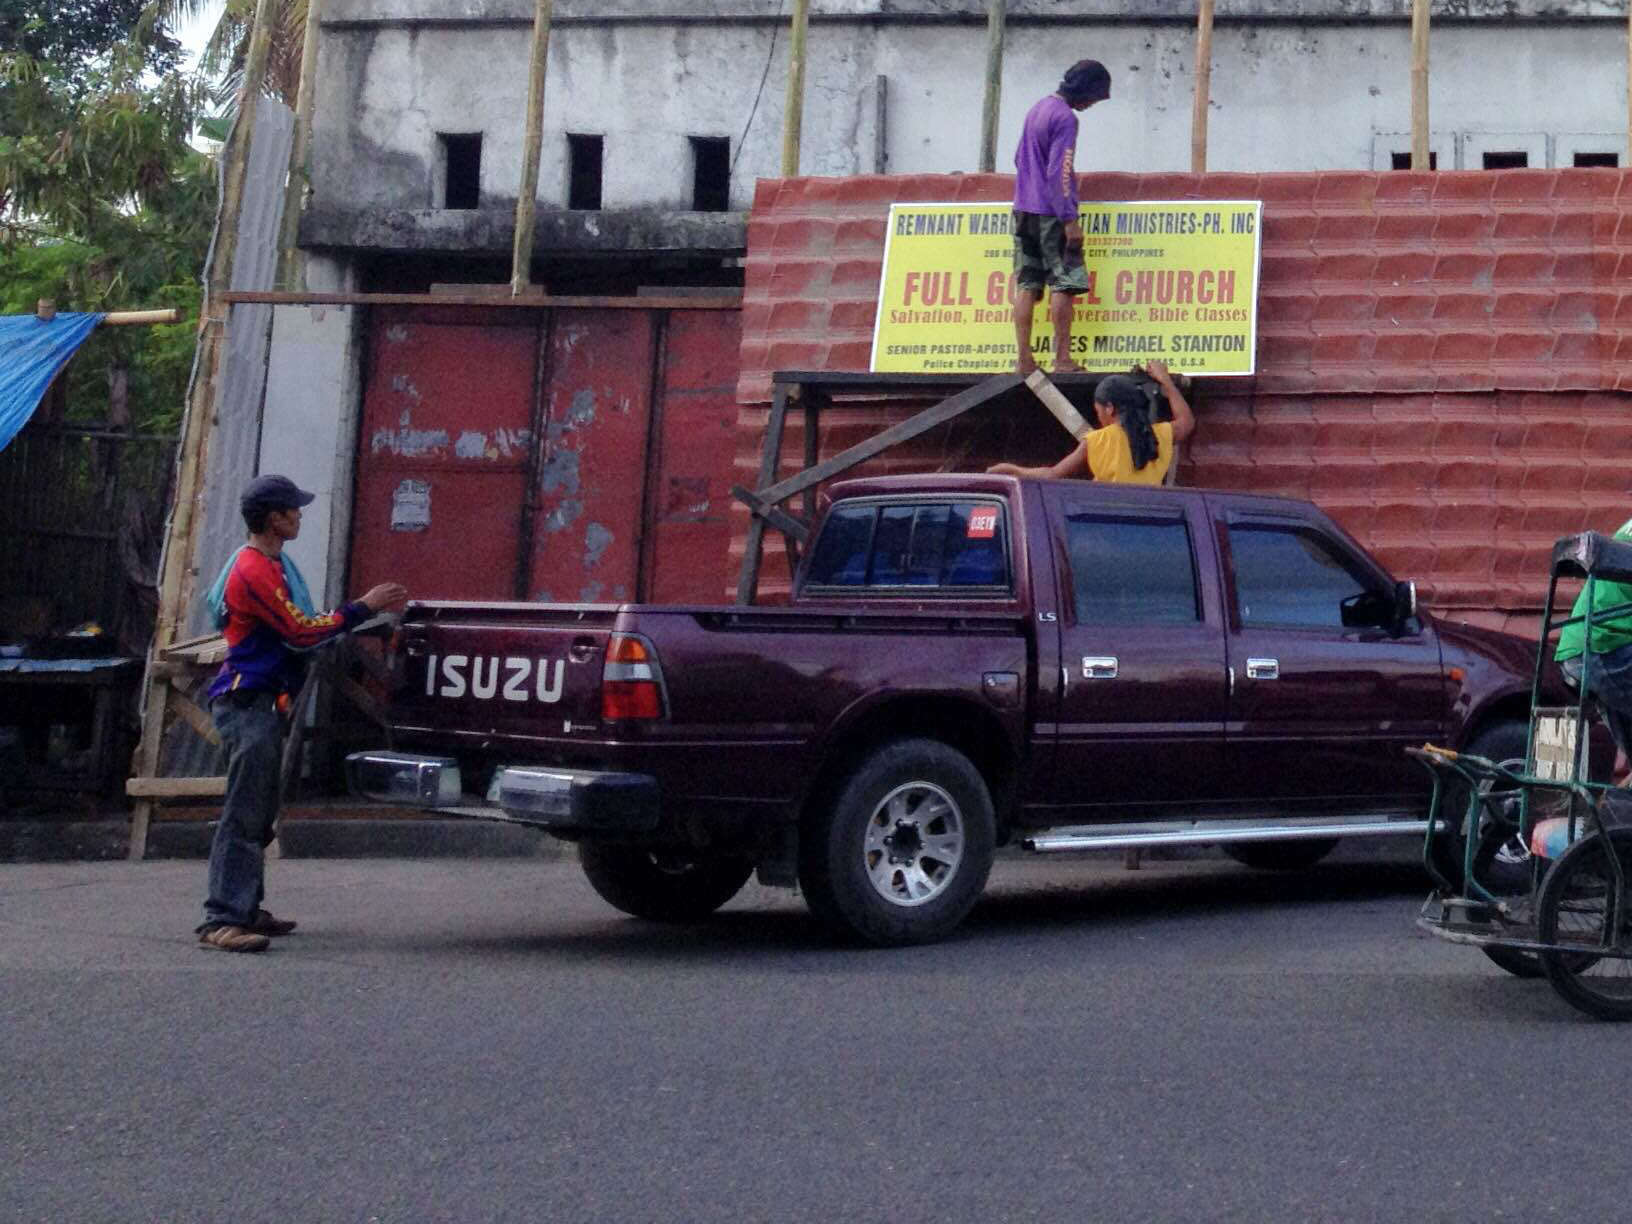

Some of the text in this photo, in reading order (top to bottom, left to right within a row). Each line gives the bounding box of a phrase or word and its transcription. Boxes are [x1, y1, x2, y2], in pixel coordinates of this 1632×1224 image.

[895, 213, 964, 235] REMNANT
[1112, 248, 1165, 257] PHILIPPINES
[903, 271, 973, 306] FULL
[1115, 270, 1236, 305] CHURCH
[890, 309, 967, 324] Salvation,
[1148, 308, 1189, 322] Bible
[1195, 308, 1248, 322] Classes
[887, 335, 1246, 355] SENIOR PASTOR-APOSTL JAES MICHAEL STANTON
[923, 360, 954, 369] Police
[1039, 612, 1057, 622] LS
[425, 654, 565, 703] ISUZU
